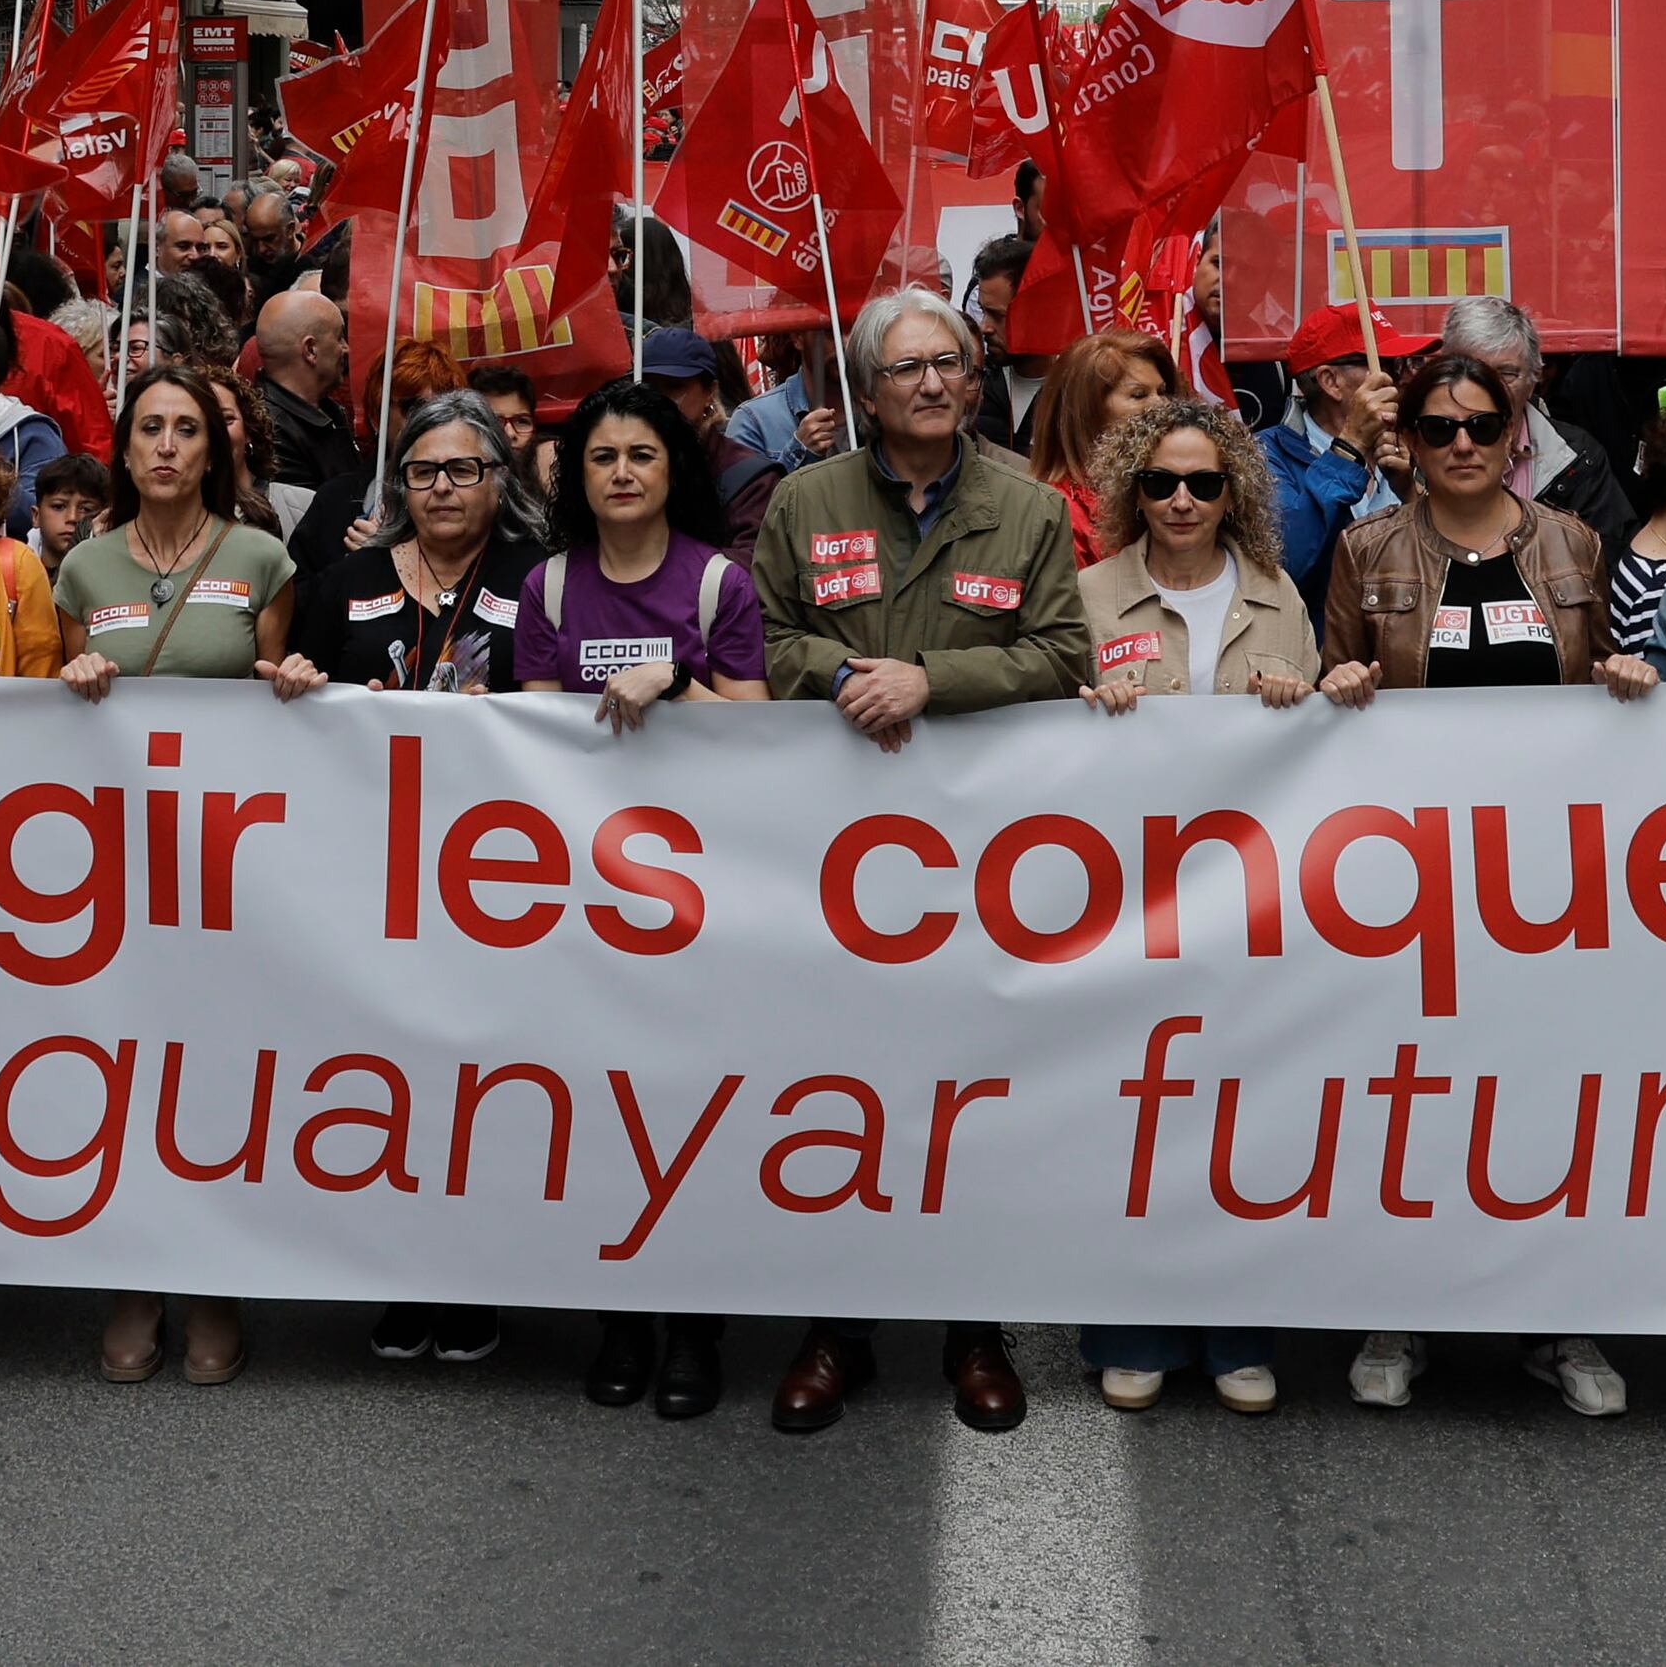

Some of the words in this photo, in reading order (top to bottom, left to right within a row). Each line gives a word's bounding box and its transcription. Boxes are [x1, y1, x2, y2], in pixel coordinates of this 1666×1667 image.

[192, 27, 235, 38] EMT
[925, 65, 971, 91] país
[815, 539, 850, 555] UGT
[816, 577, 851, 598] UGT
[955, 580, 992, 598] UGT
[351, 594, 393, 612] CCOO
[92, 606, 130, 623] CCOO
[1488, 606, 1536, 624] UGT
[1527, 624, 1553, 639] FIC
[585, 644, 640, 659] CCOO
[1101, 641, 1133, 663] UGT
[384, 735, 705, 955] les
